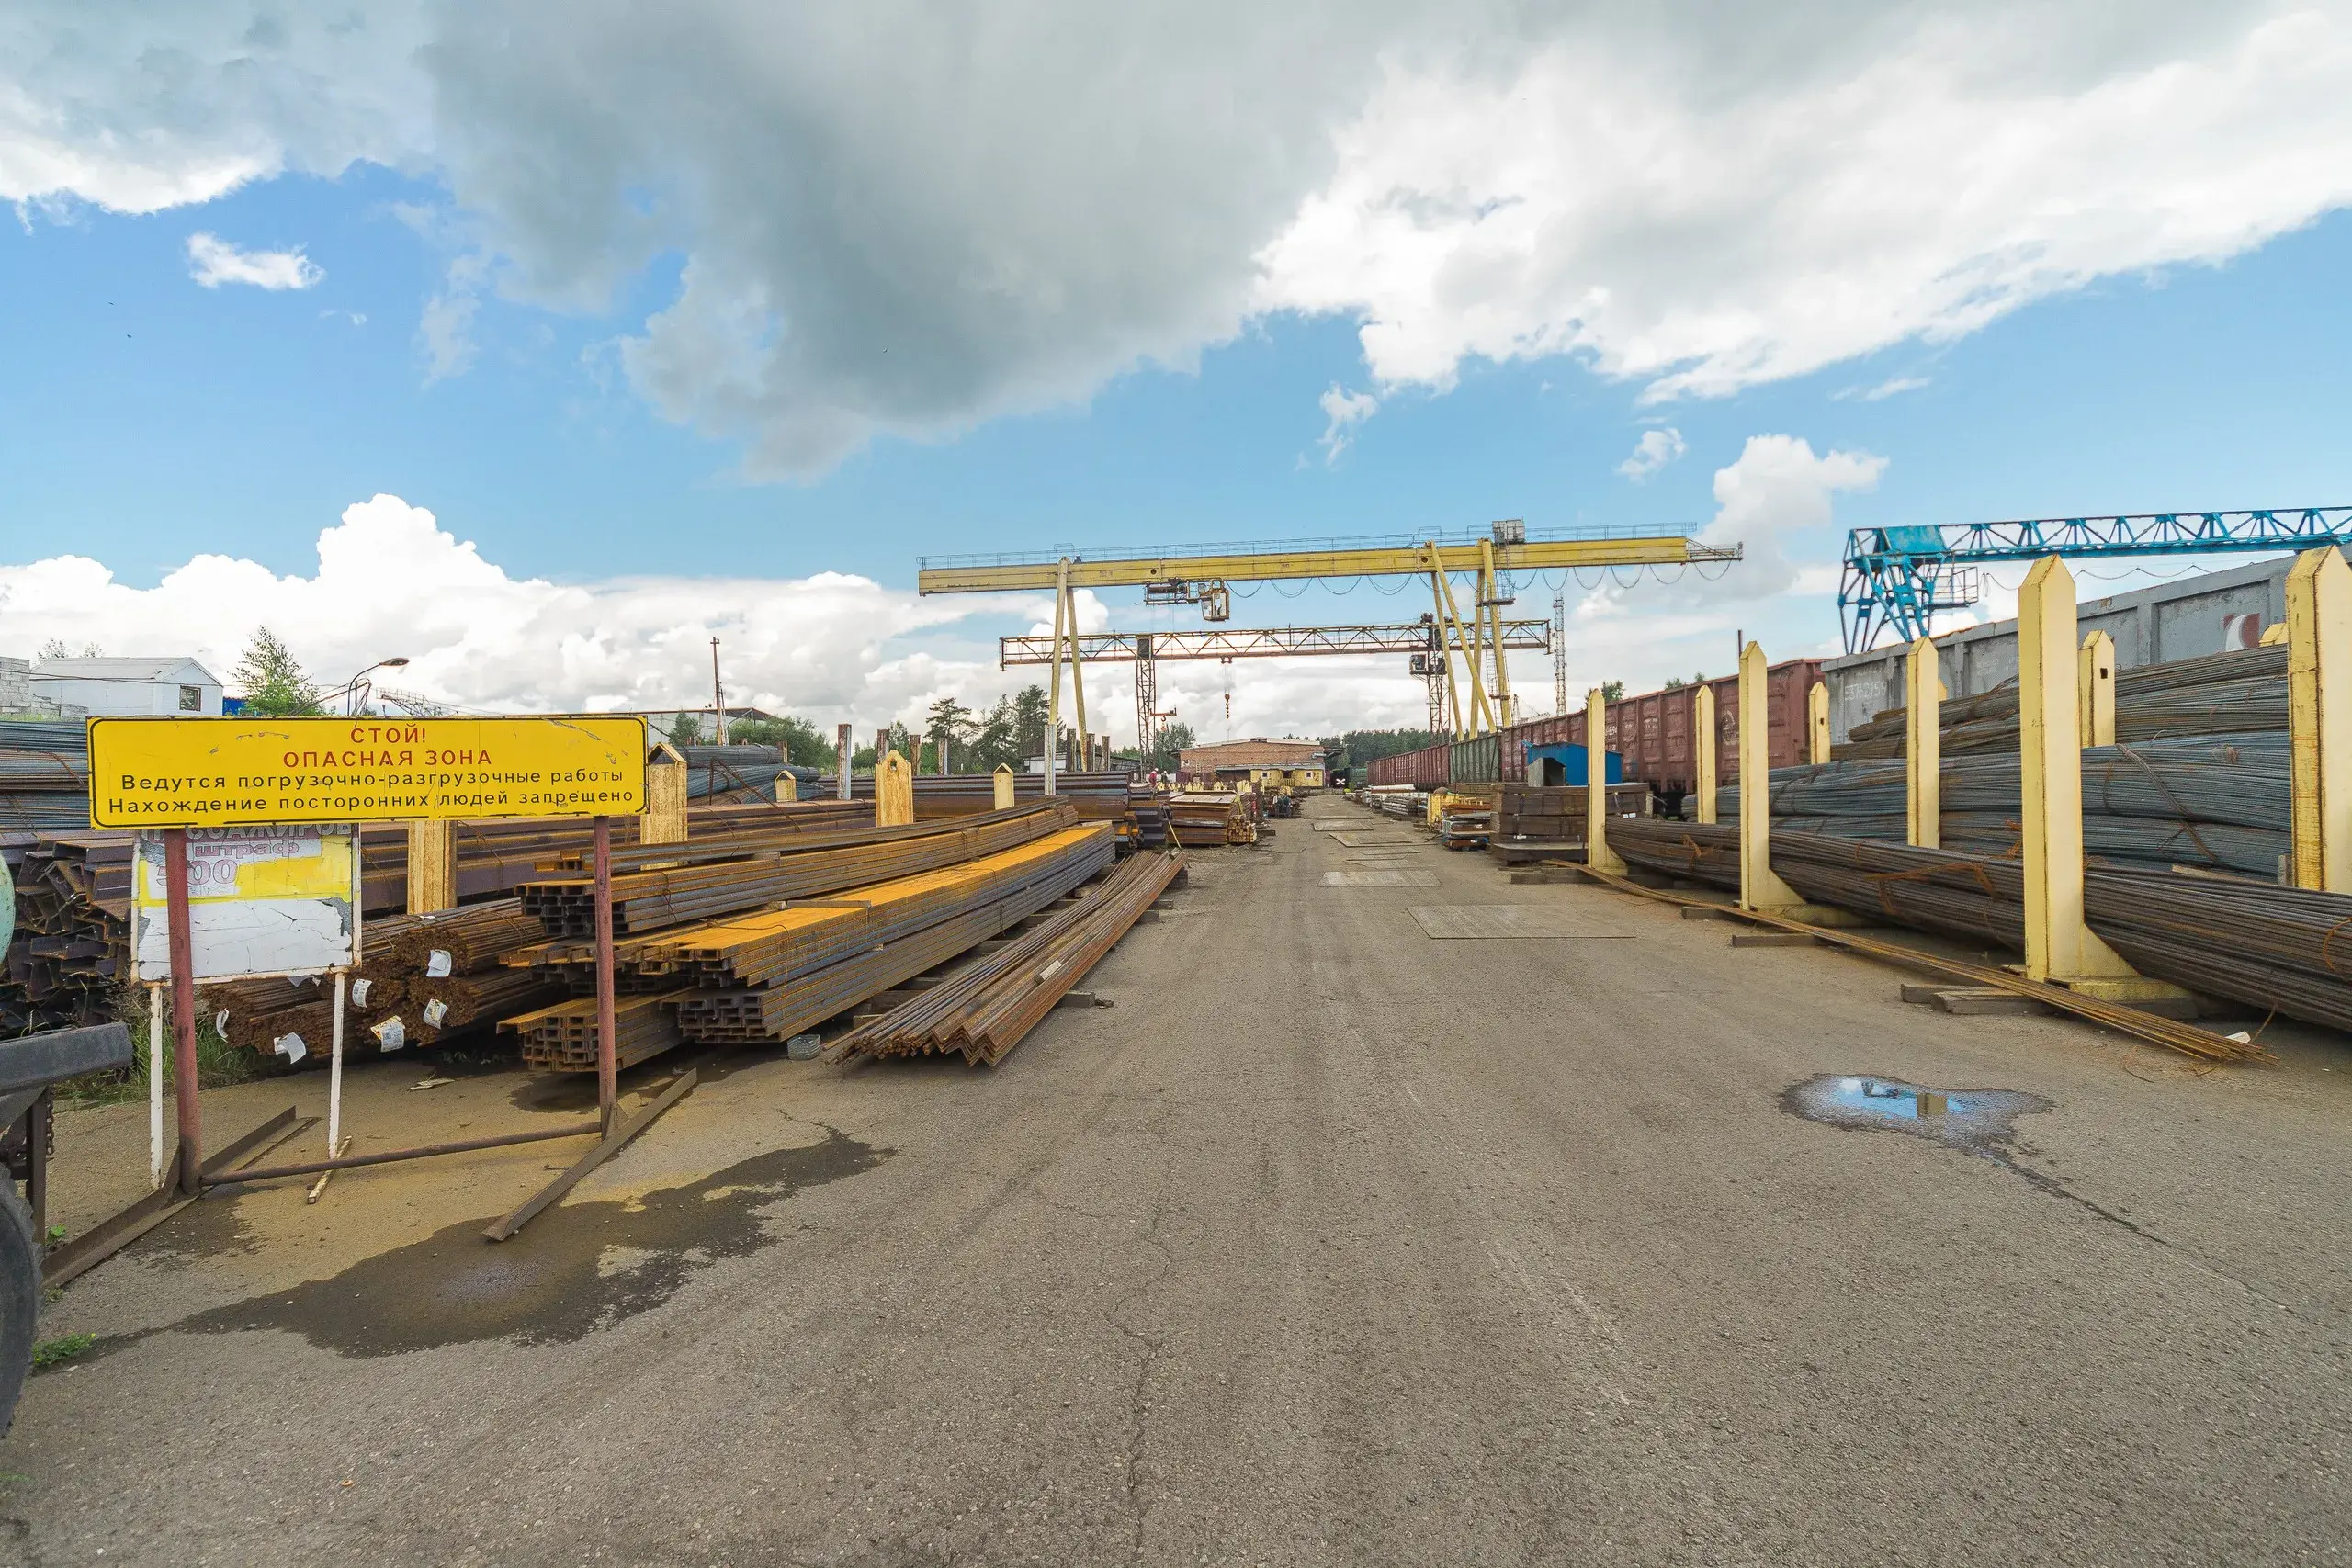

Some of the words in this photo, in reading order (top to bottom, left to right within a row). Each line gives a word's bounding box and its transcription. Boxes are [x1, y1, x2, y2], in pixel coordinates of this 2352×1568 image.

[350, 723, 426, 744] СТОЙ!
[283, 750, 413, 768] ОПАСНАЯ
[424, 749, 492, 766] ЗОНА
[121, 774, 226, 793] Ведутся
[238, 770, 541, 791] погрузочно-разгрузочные
[551, 768, 624, 788] работы
[108, 797, 267, 814] Нахождение
[279, 795, 429, 811] посторонних
[439, 790, 508, 807] людей
[518, 791, 634, 807] запрещено
[195, 840, 300, 859] штраф
